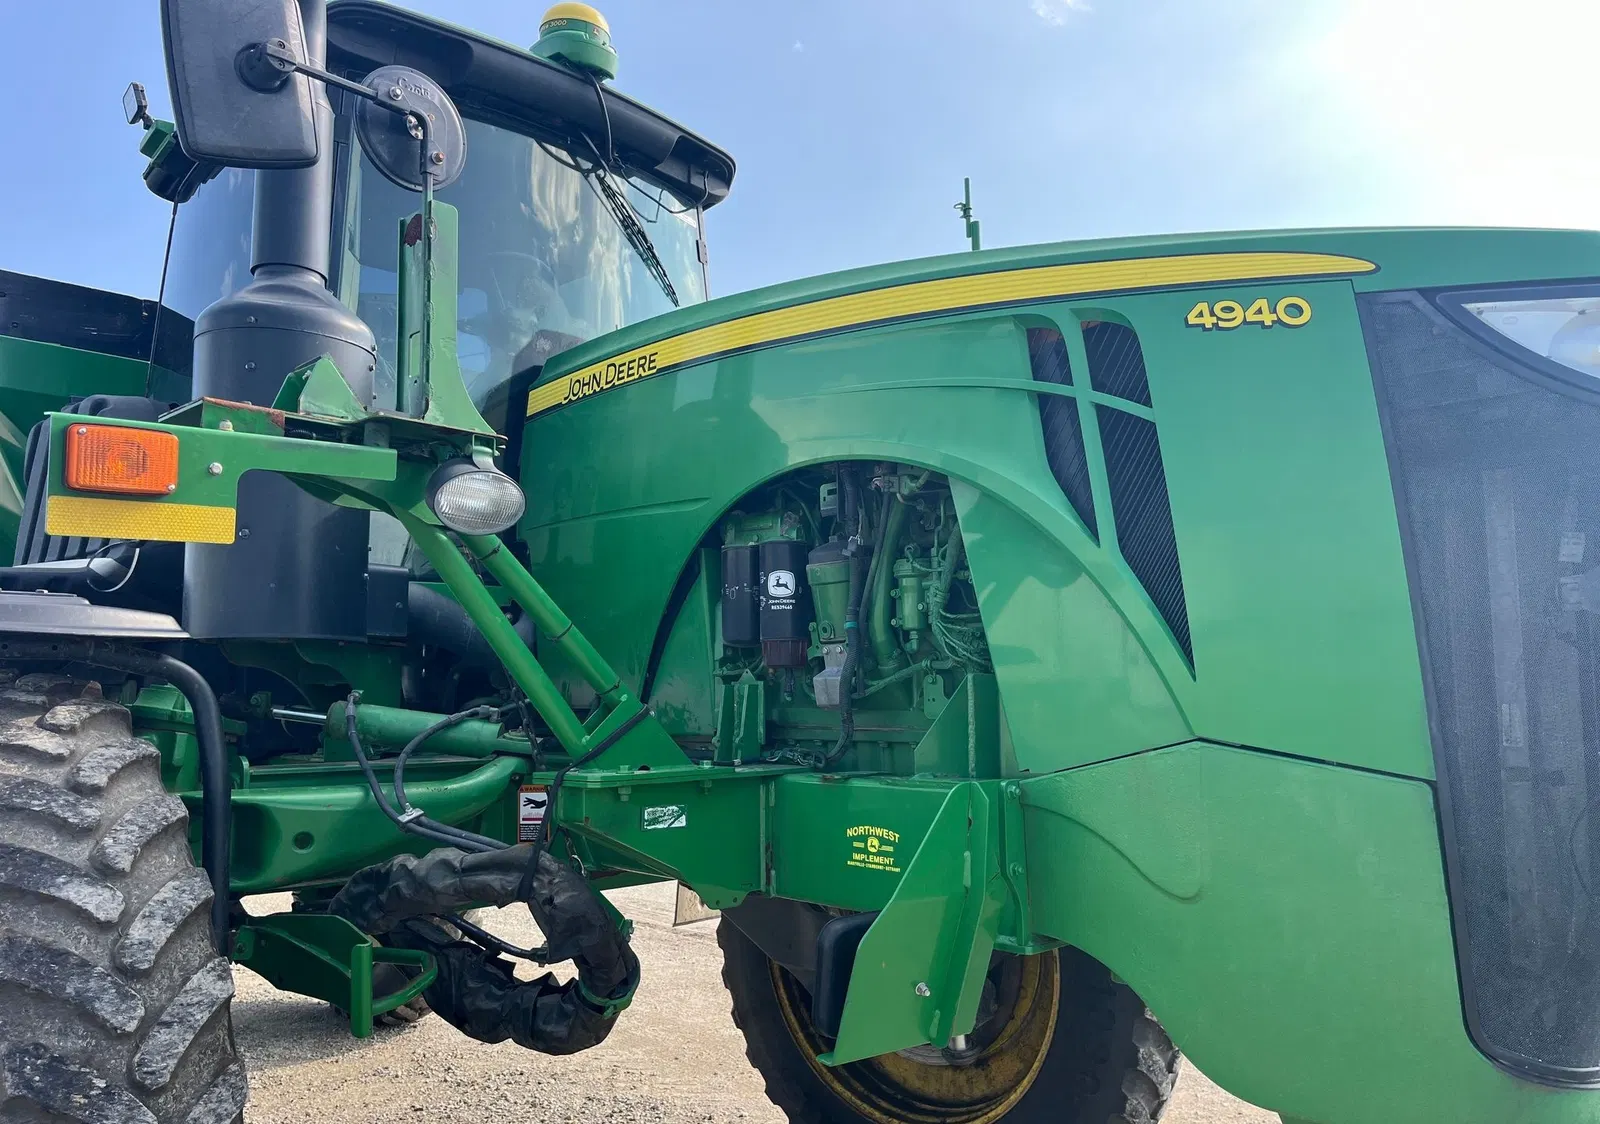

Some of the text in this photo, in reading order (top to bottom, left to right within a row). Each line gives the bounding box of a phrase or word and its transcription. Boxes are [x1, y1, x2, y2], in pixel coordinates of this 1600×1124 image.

[1185, 296, 1312, 332] 4940
[563, 352, 659, 402] JOHN DEERE
[846, 825, 900, 843] NORTHWEST
[852, 852, 895, 866] IMPLEMENT
